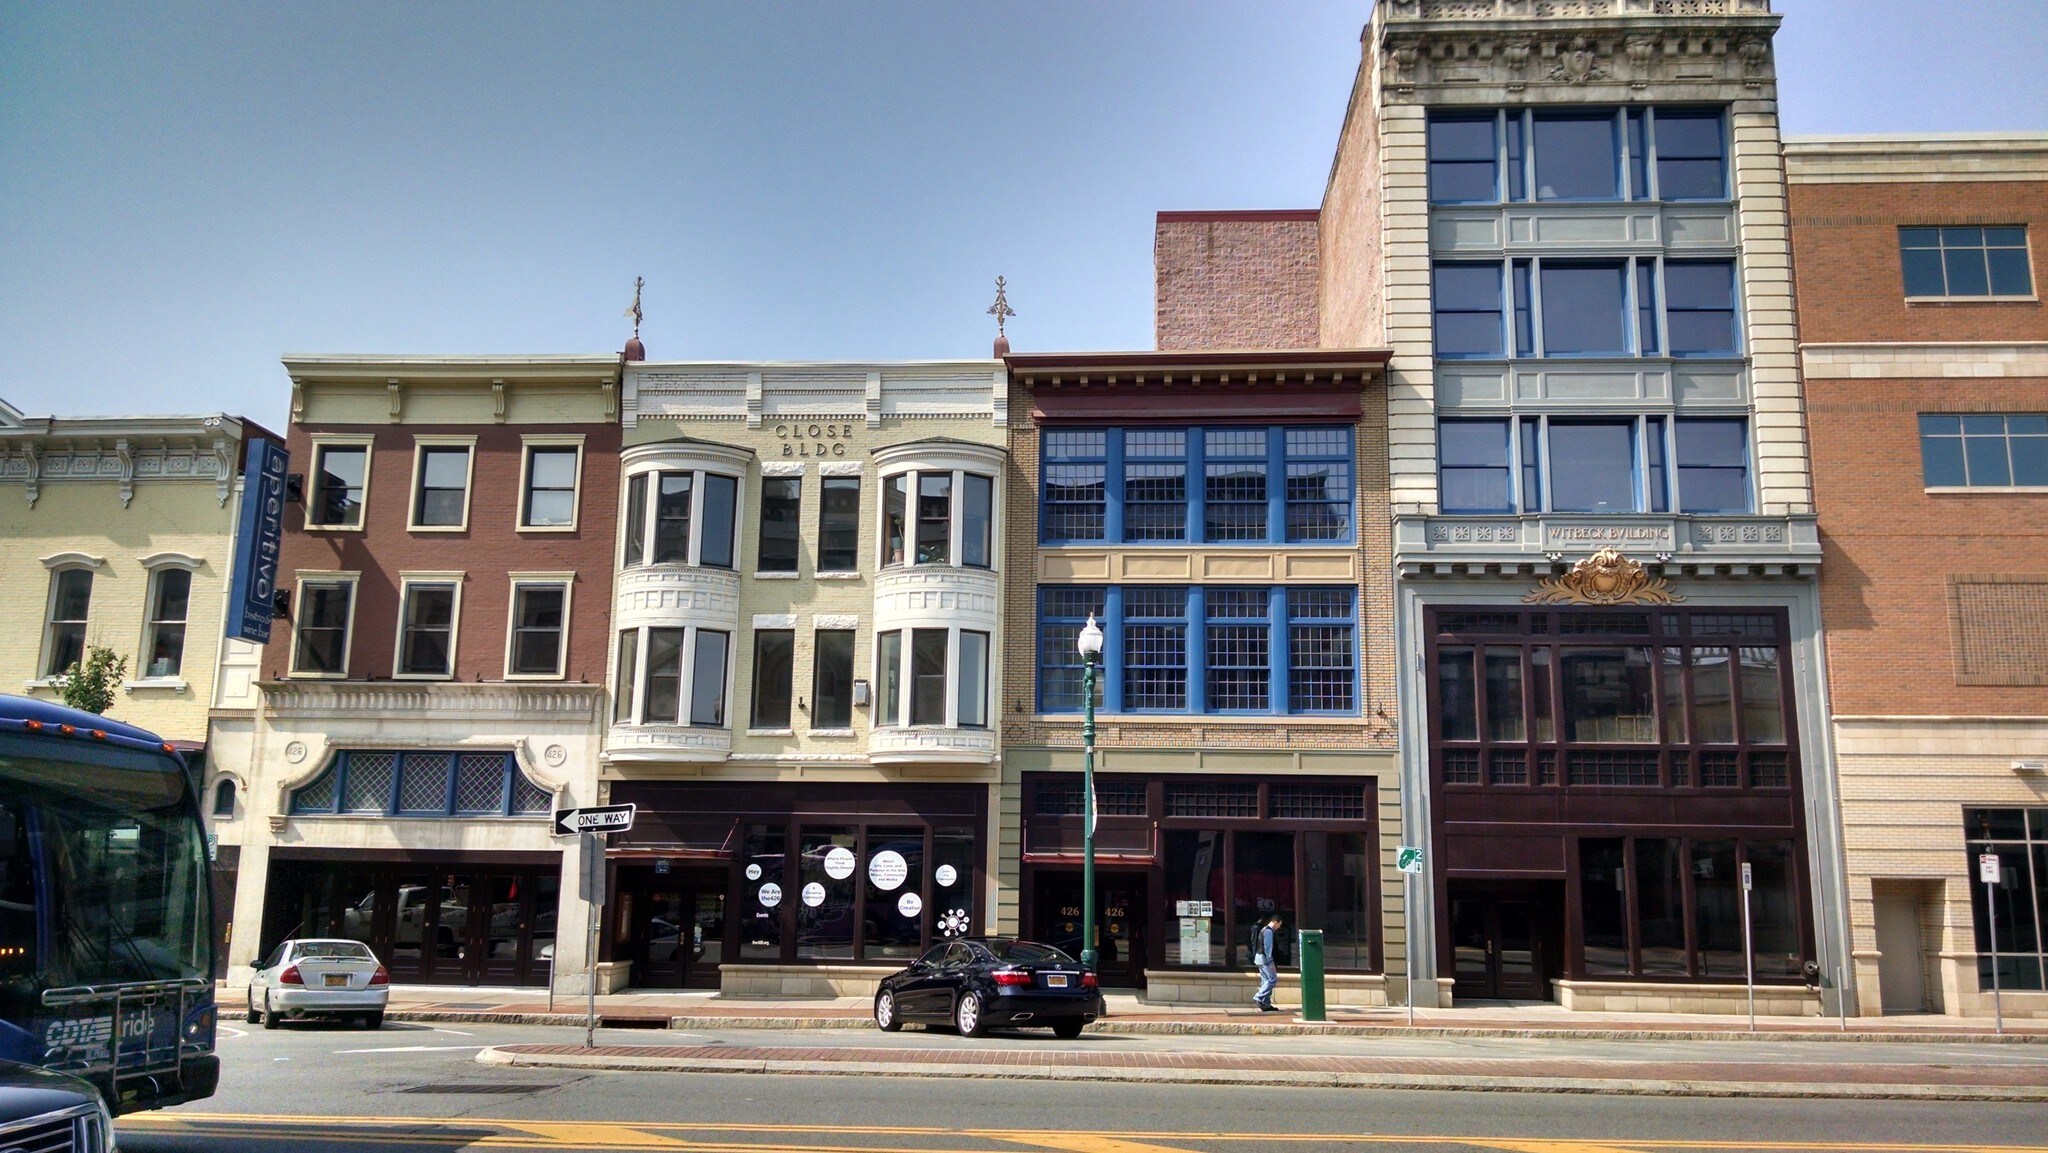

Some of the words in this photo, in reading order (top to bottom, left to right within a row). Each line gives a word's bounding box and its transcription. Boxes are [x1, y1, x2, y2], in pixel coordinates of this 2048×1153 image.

[776, 424, 852, 438] CLOSE
[782, 443, 845, 456] BLDG
[257, 454, 285, 600] aperitivo
[1549, 527, 1606, 540] WITBECK
[245, 604, 264, 622] bistro
[243, 623, 258, 636] wine
[258, 623, 270, 638] bar
[287, 746, 303, 756] 426
[546, 750, 562, 759] 426
[578, 814, 599, 826] ONE
[604, 812, 627, 824] WAY
[1416, 850, 1422, 860] 2
[748, 868, 760, 876] Hey
[1060, 906, 1080, 917] 426
[1105, 907, 1125, 917] 426
[45, 1016, 112, 1047] CDTA
[122, 1009, 155, 1038] ride
